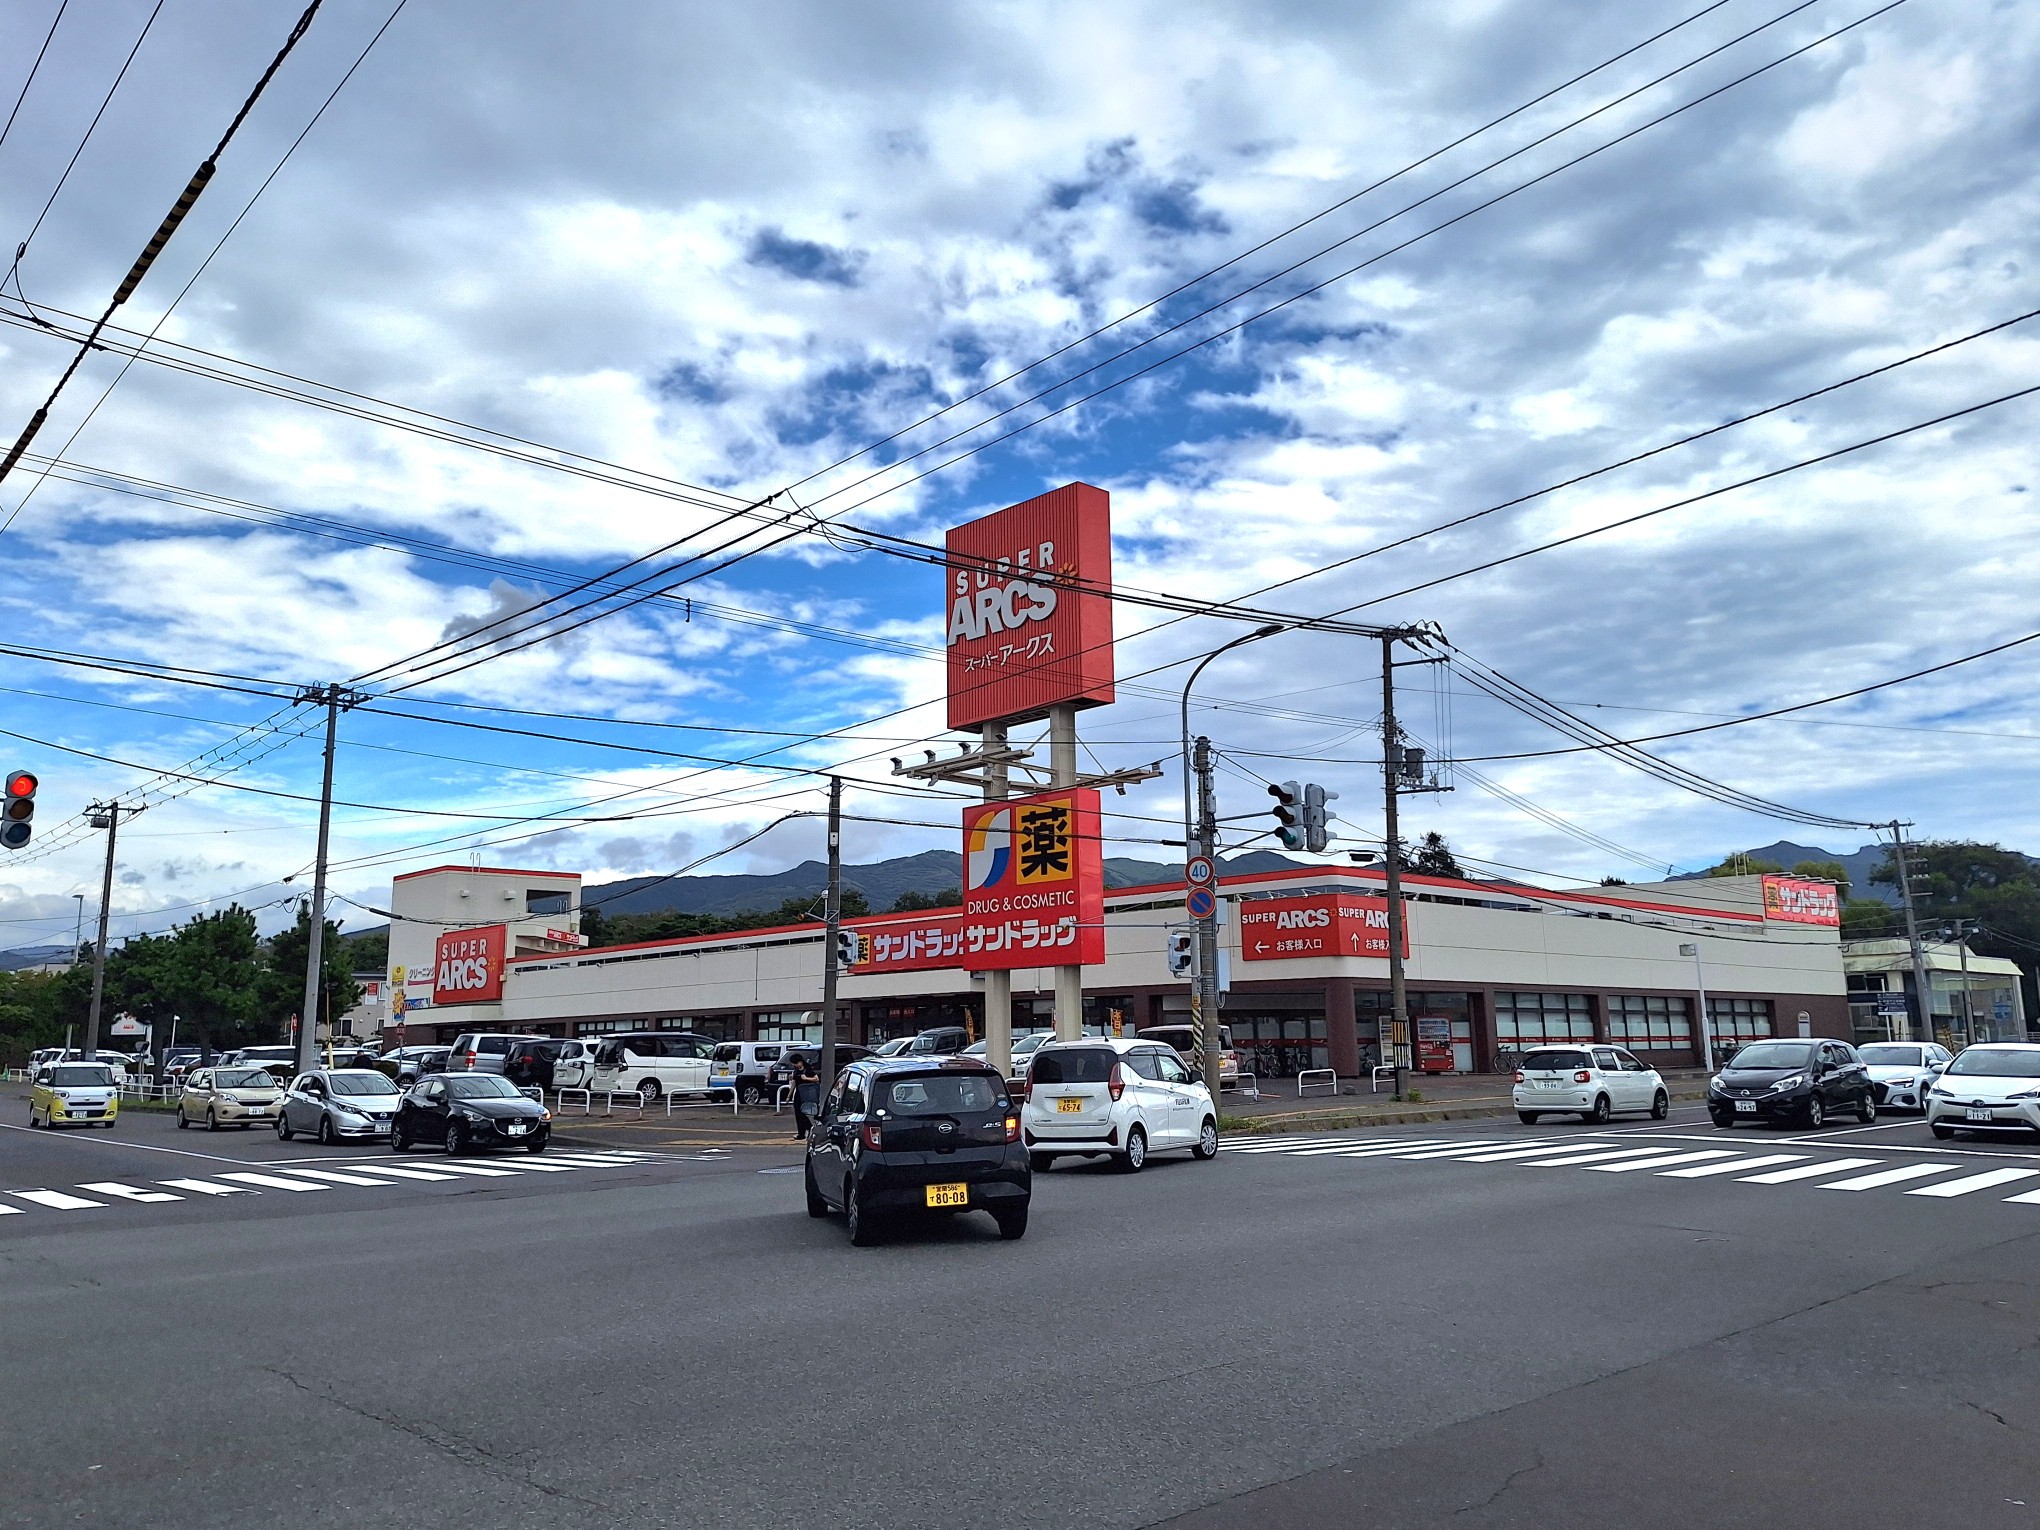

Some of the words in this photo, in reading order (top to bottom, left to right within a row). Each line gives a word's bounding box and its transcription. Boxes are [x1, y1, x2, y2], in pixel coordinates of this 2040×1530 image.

[956, 541, 1055, 595] SUPER
[947, 572, 1058, 646] ARCS
[964, 632, 1055, 673] スーパーアークス
[1021, 806, 1069, 879] 薬
[1191, 864, 1208, 878] 40
[968, 899, 1000, 915] DRUG
[1002, 897, 1012, 911] &
[1013, 890, 1075, 910] COSMETIC
[1338, 906, 1365, 919] SUPER
[1780, 886, 1837, 918] サンドラッグ
[1242, 911, 1276, 925] SUPER
[1276, 908, 1330, 930] ARCS
[966, 915, 1078, 952] サンドラッグ
[1276, 939, 1323, 952] お客様入口
[441, 938, 488, 960] SUPER
[436, 956, 488, 992] ARCS
[936, 1191, 966, 1204] 80-08
